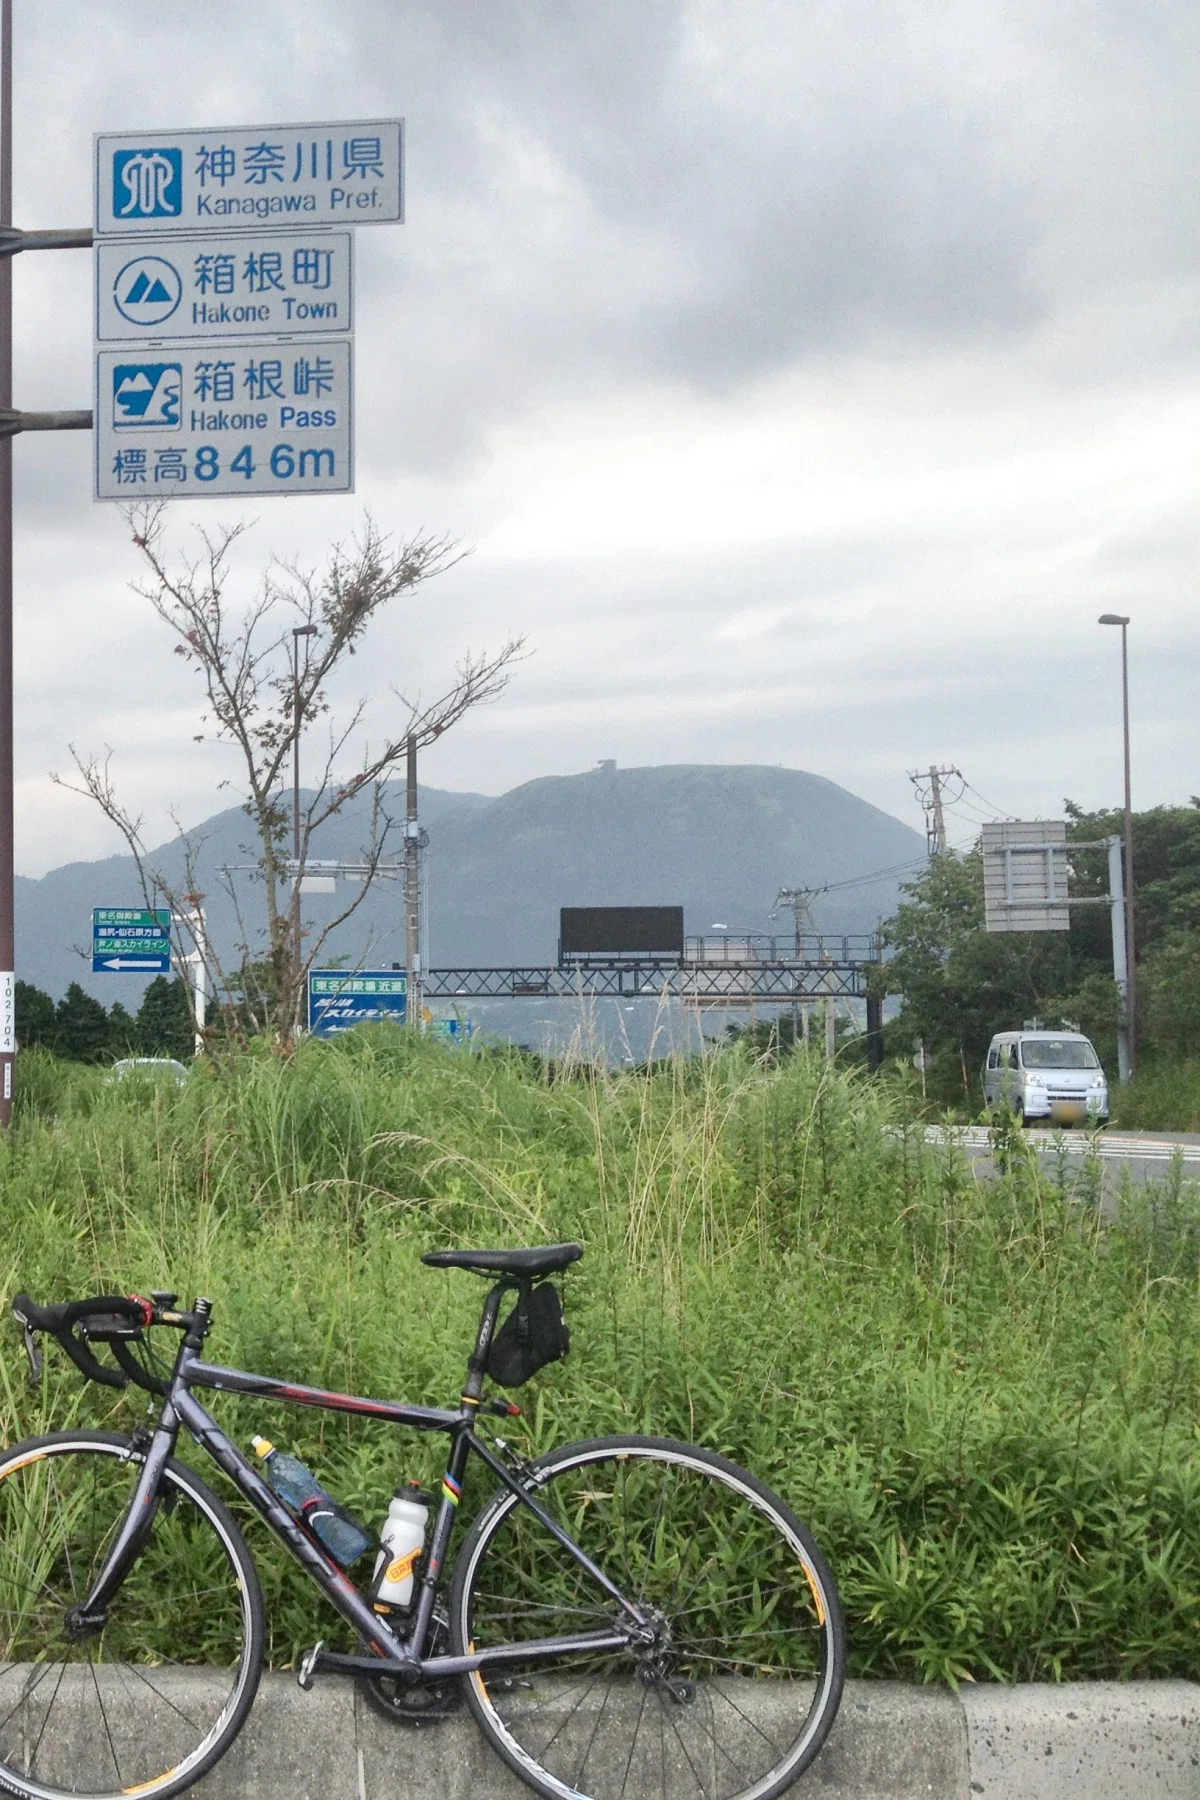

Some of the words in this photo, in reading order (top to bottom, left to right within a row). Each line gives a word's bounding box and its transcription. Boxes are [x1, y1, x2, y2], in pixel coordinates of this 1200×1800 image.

[194, 137, 384, 187] 神奈川県
[197, 194, 316, 218] Kanagawa
[330, 187, 382, 210] Pref.
[193, 248, 334, 295] 箱根町
[192, 300, 270, 324] Hakone
[283, 297, 337, 321] Town
[193, 356, 334, 402] 箱根峠
[191, 410, 267, 431] Hakone
[280, 406, 336, 428] Pass
